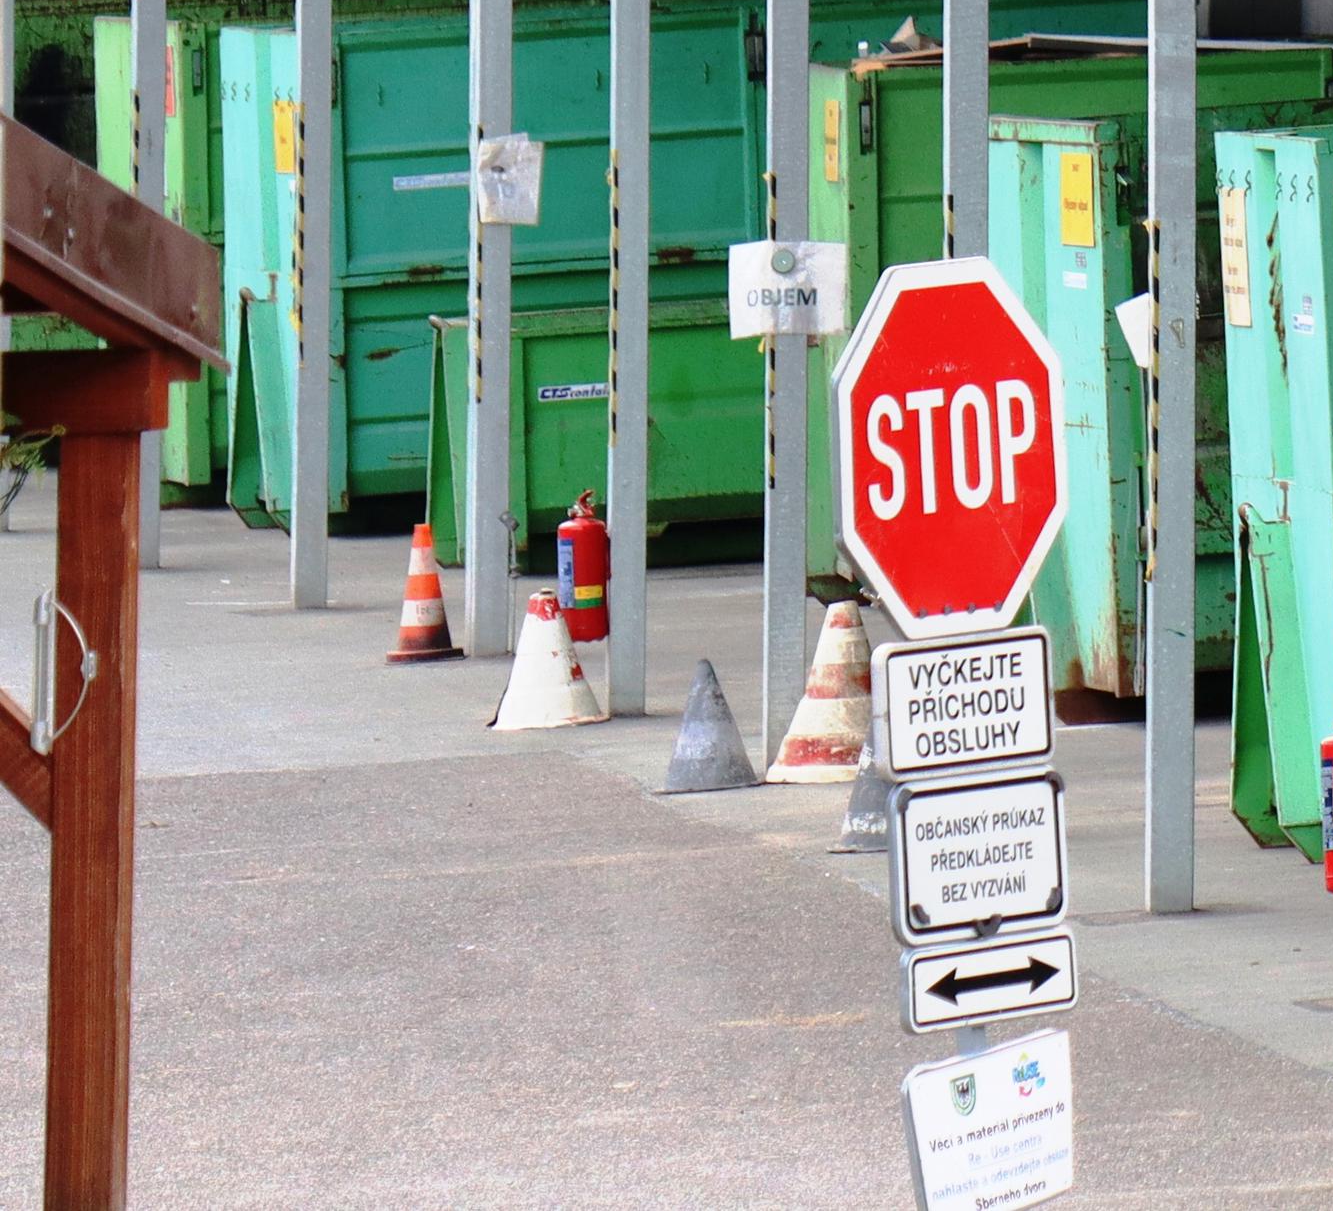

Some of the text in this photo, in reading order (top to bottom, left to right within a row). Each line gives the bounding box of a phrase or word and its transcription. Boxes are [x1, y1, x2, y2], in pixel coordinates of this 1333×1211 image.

[747, 288, 818, 307] OBJEM
[866, 379, 1036, 521] STOP
[909, 652, 1023, 690] VYČKEJTE
[908, 686, 1025, 725] PŘÍCHODU
[916, 721, 1020, 758] OBSLUHY
[915, 809, 989, 841] OBČANSKÝ
[931, 841, 1033, 872] PŘEDKLÁDEJTE
[942, 870, 1027, 904] BEZ VYZVÁNÍ
